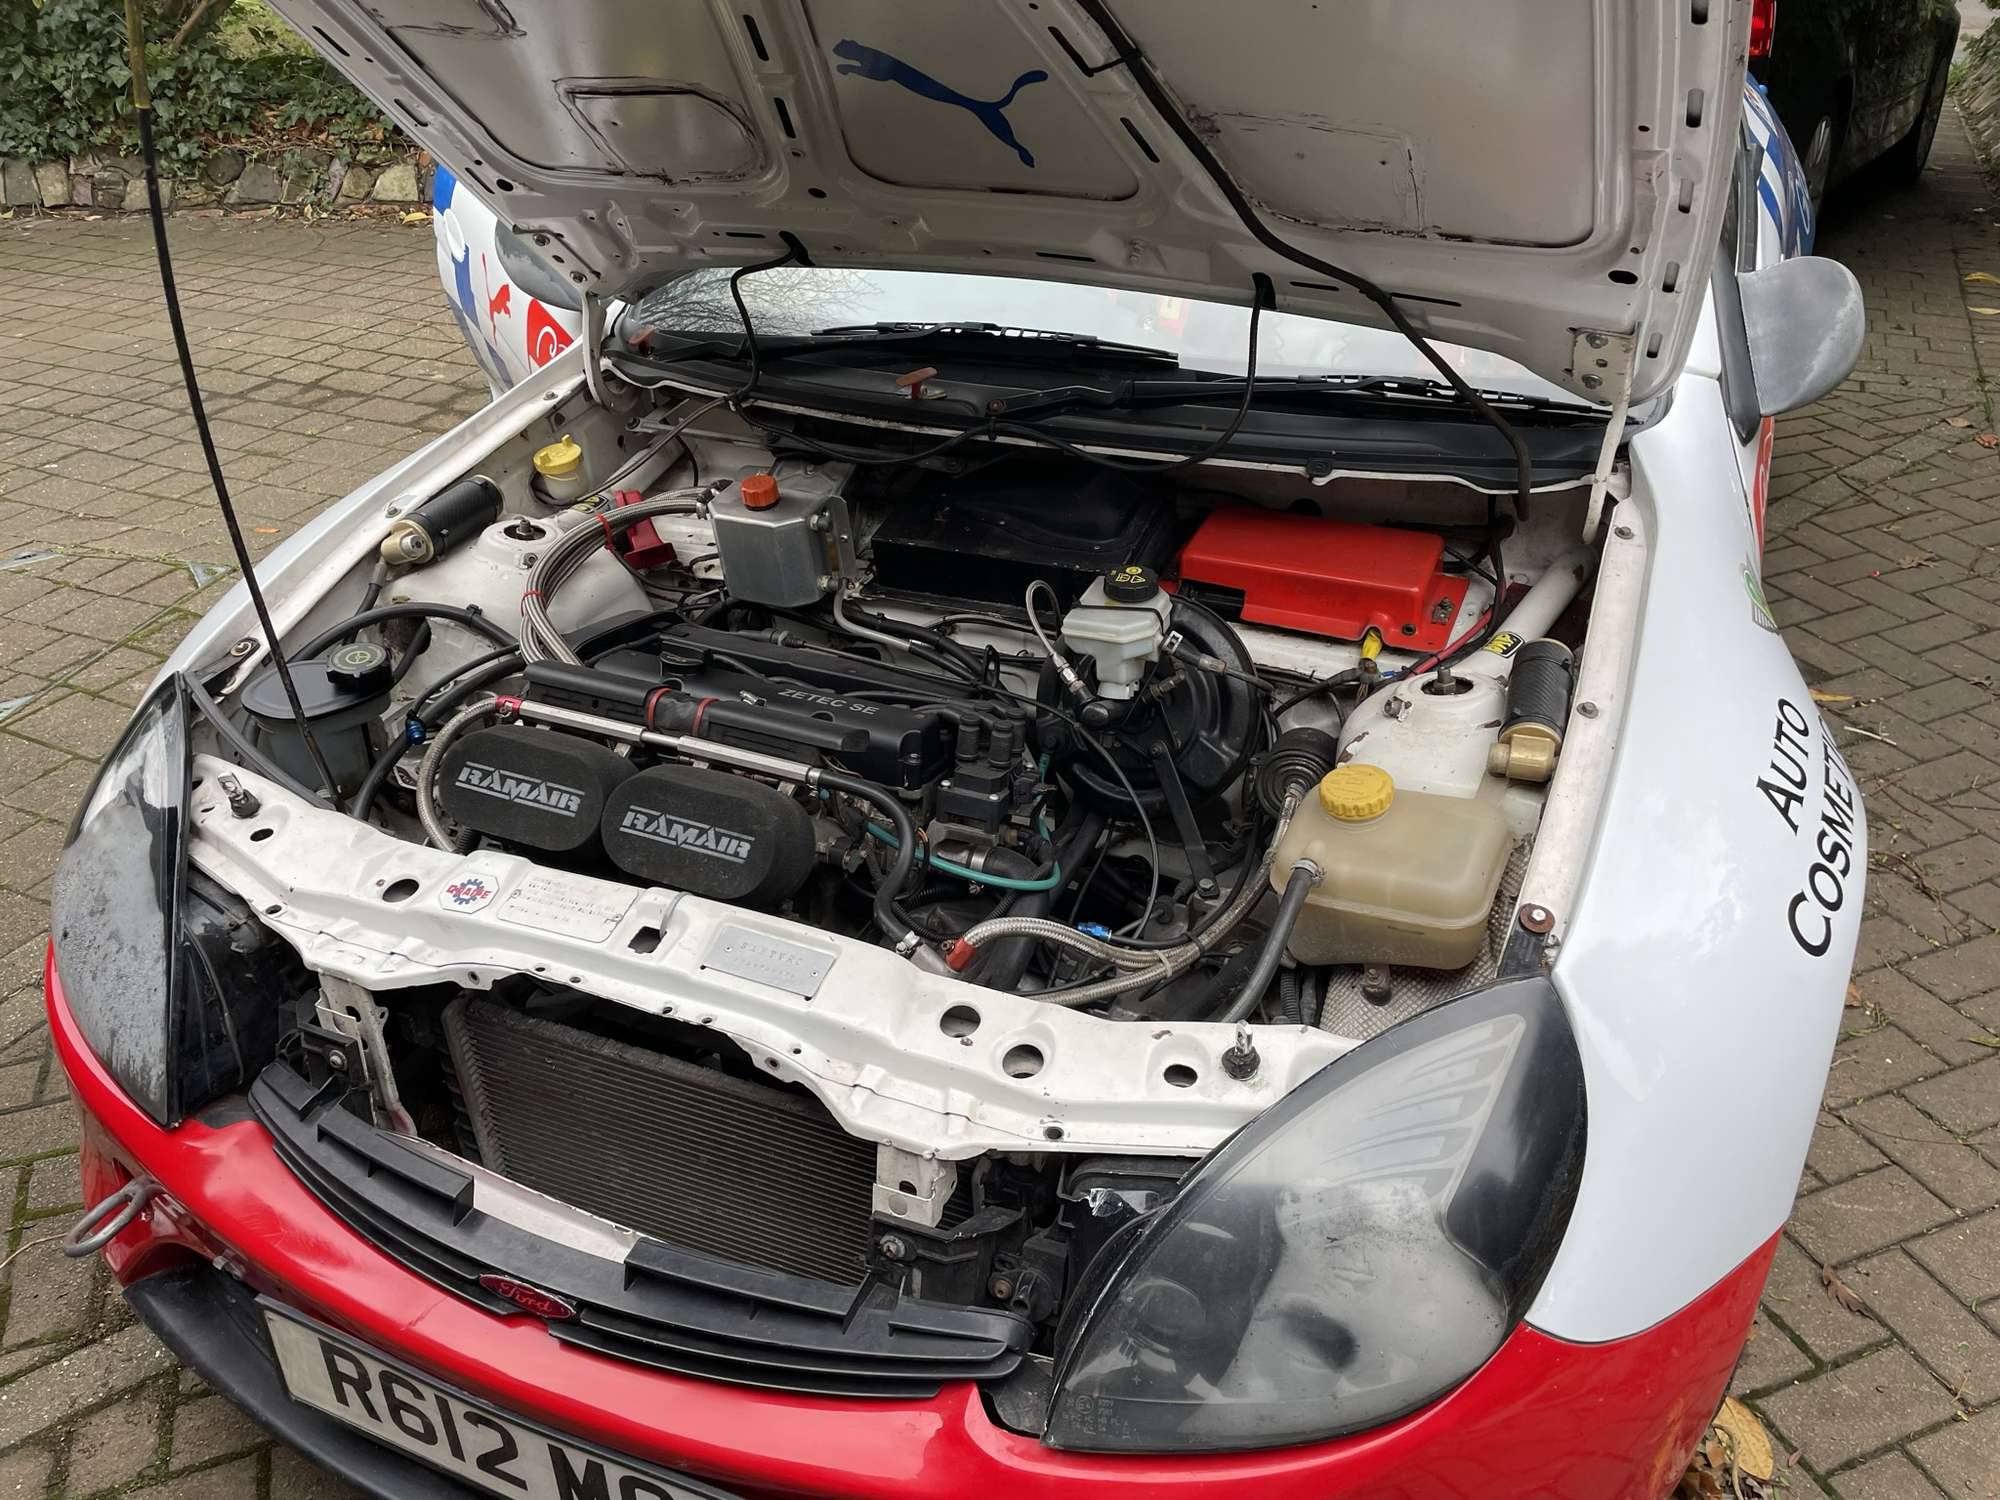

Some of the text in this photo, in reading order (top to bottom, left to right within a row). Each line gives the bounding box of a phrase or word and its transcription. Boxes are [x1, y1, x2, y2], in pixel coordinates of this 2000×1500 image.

[778, 688, 880, 715] ZETEC SE
[457, 765, 582, 814] RAMAIR
[1756, 698, 1810, 836] AUTO
[621, 810, 752, 860] RAMAIR
[500, 1282, 552, 1312] Ford
[317, 1337, 674, 1500] R612 M
